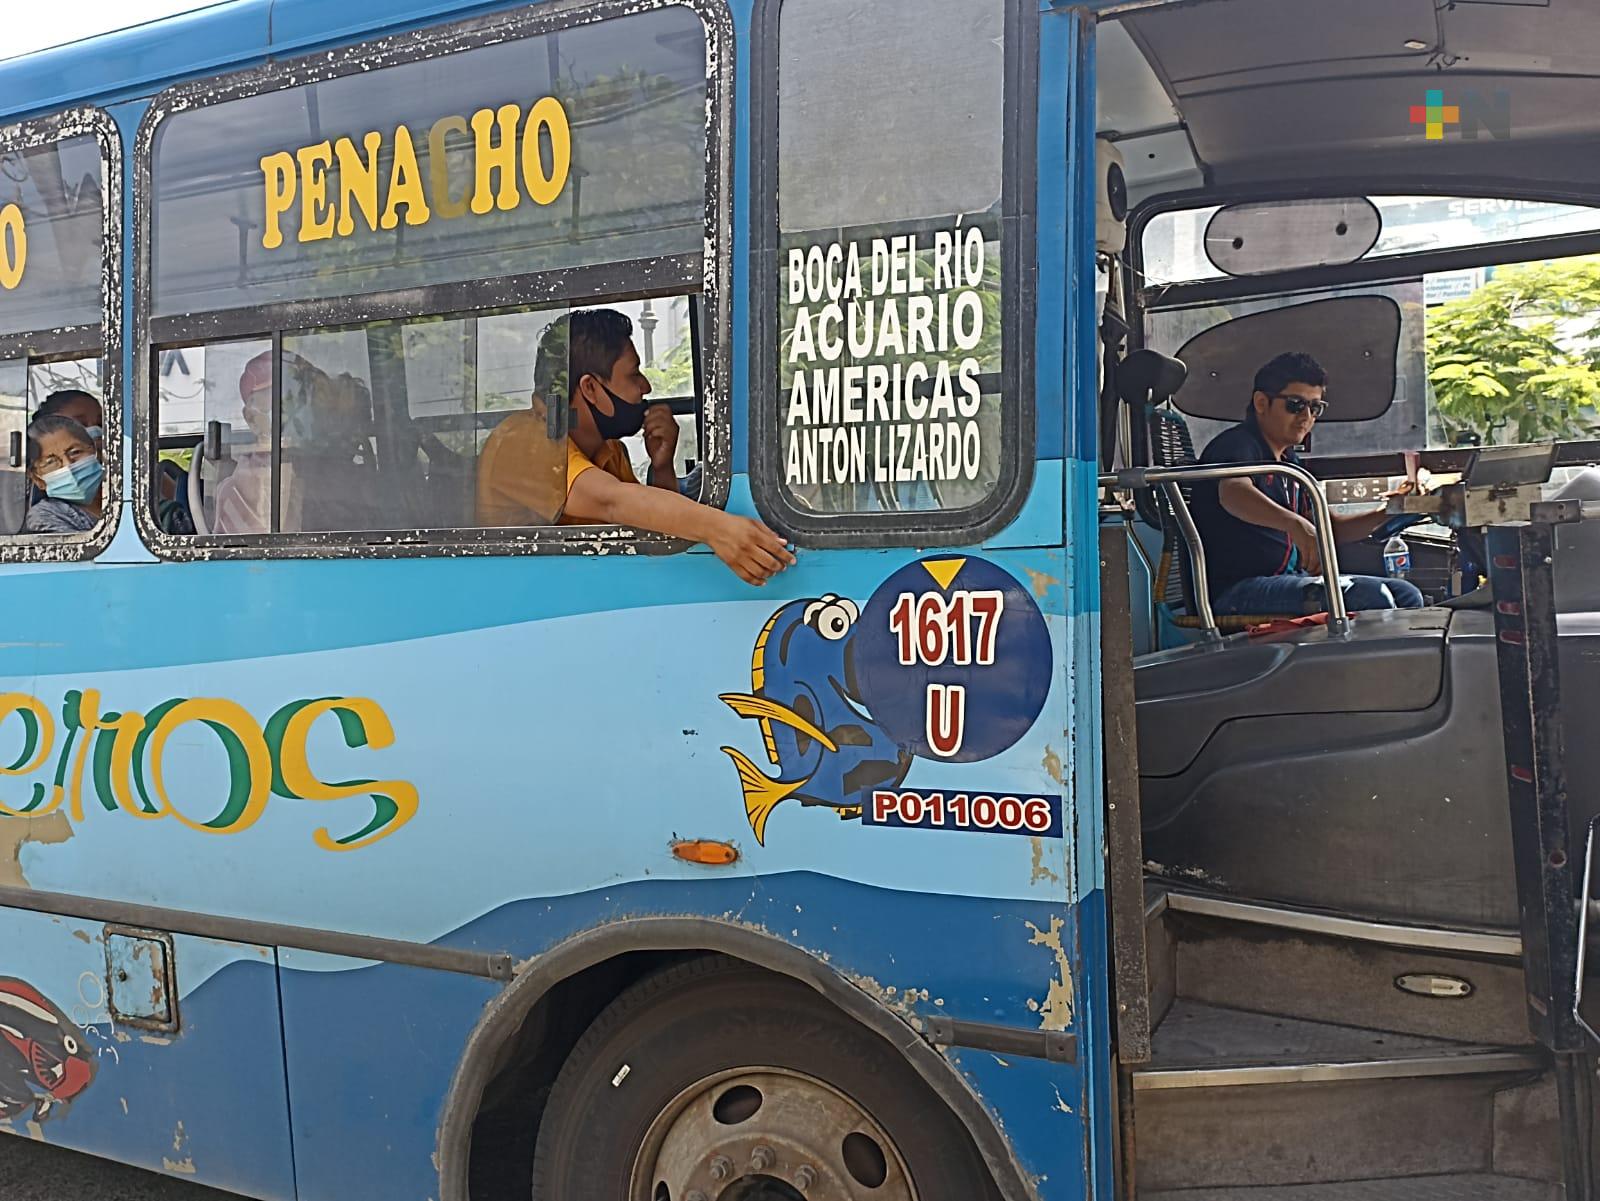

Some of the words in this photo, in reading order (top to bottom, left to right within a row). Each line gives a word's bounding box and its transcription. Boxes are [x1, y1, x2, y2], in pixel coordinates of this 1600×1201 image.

[260, 97, 571, 249] PENACHO
[789, 242, 863, 304] BOCA
[872, 235, 925, 296] DEL
[935, 215, 984, 290] RÍO
[788, 291, 984, 363] ACUARIO
[787, 358, 981, 426] AMERICAS
[786, 425, 866, 485] ANTON
[874, 420, 981, 482] LIZARDO
[890, 591, 1003, 666] 1617
[927, 684, 965, 756] U
[873, 791, 1052, 831] P011006
